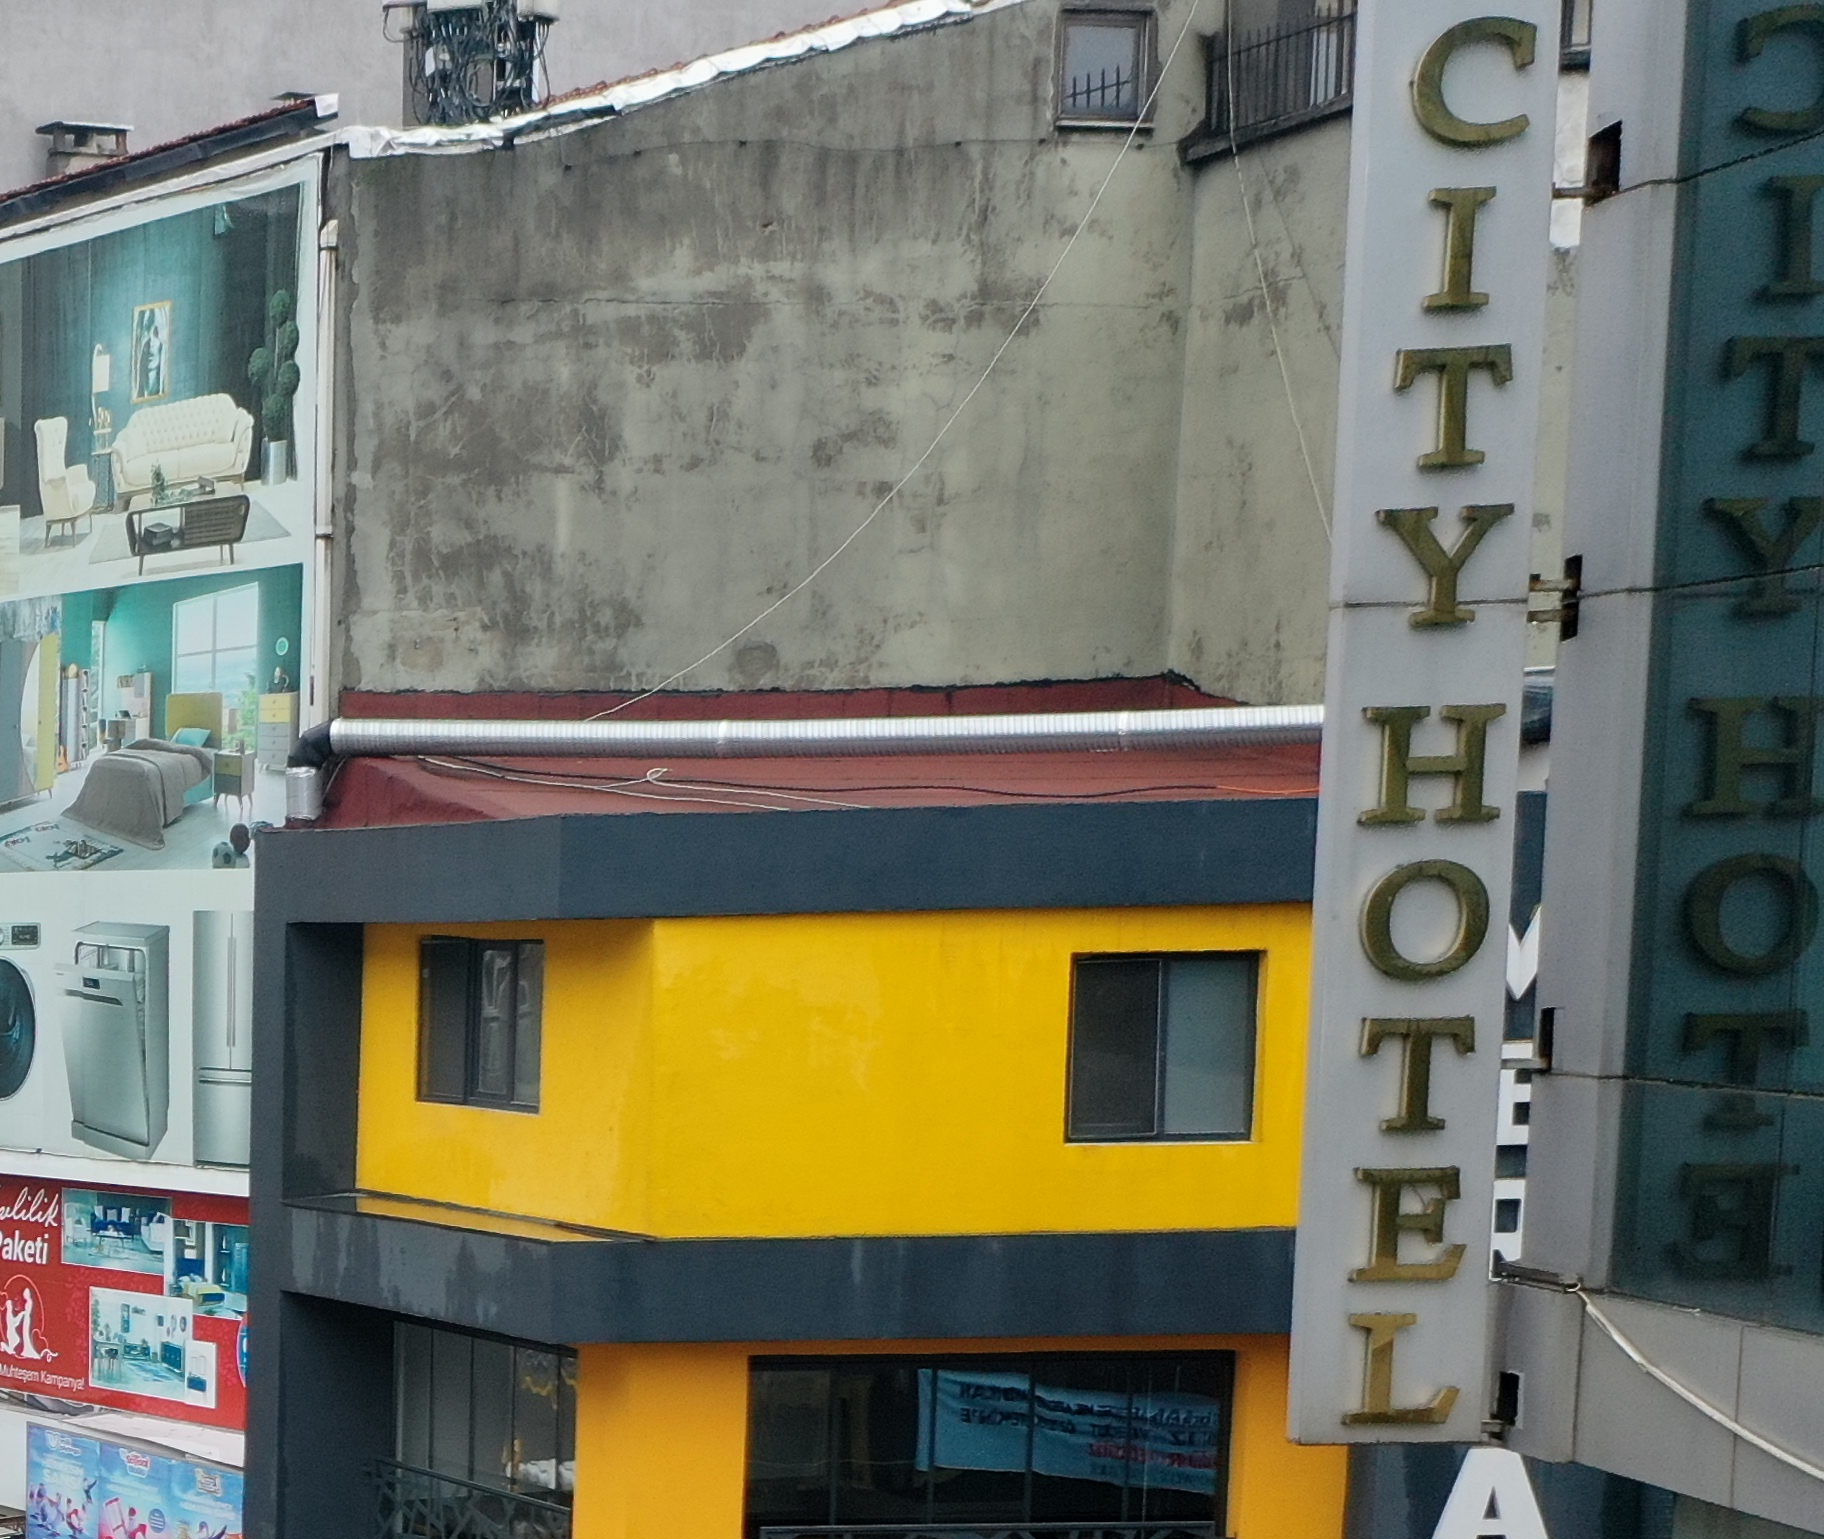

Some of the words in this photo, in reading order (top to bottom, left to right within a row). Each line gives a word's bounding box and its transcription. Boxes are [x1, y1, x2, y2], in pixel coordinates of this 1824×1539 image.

[1375, 12, 1539, 633] CITY
[1340, 700, 1507, 1430] HOTEL
[40, 1370, 85, 1390] Kampanya!
